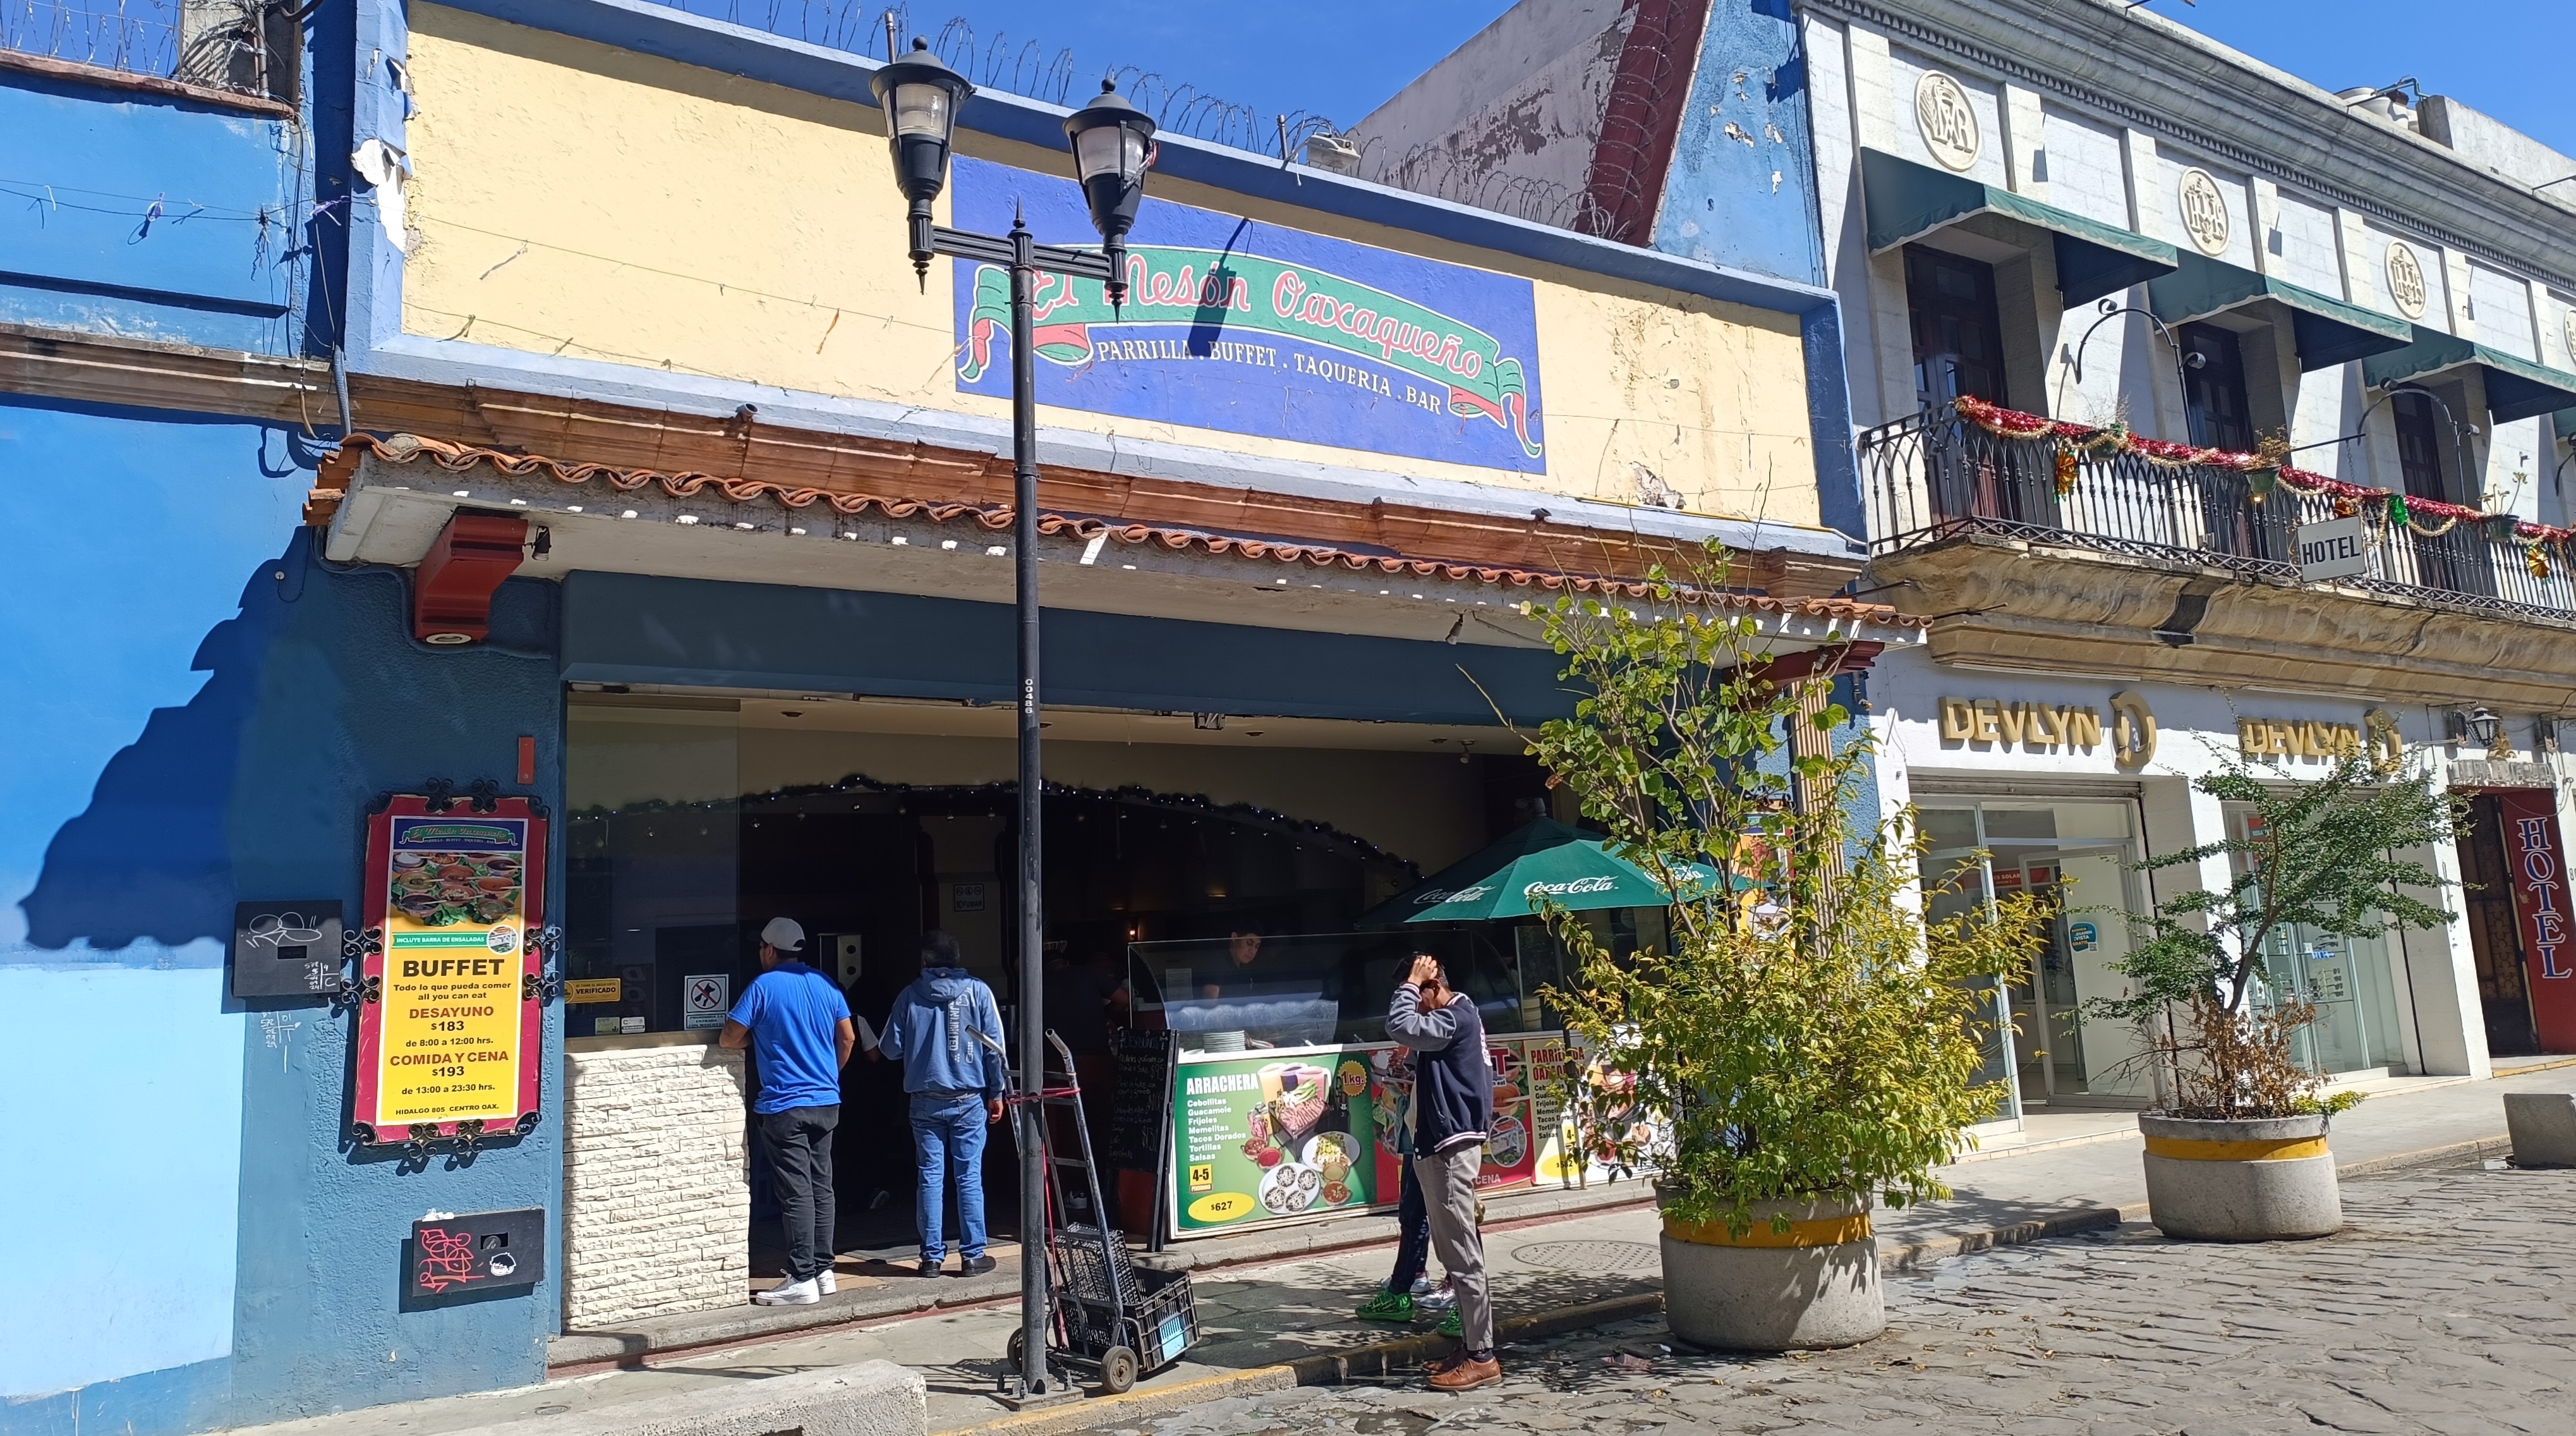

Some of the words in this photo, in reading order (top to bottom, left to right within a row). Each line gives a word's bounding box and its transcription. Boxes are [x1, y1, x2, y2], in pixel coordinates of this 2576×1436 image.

[1104, 253, 1252, 312] Mesón
[1272, 271, 1482, 379] Oaxaqueño
[1096, 341, 1195, 362] PARRILLA
[1208, 341, 1277, 368] BUFFET
[1293, 353, 1392, 398] TAQUERIA
[1405, 385, 1442, 415] BAR
[2302, 535, 2361, 565] HOTEL
[1025, 678, 1034, 714] 00486
[1938, 696, 2102, 746] DEVLYN
[2239, 717, 2362, 757] DEVLYN
[1523, 875, 1619, 896] Coca-Cola
[1413, 885, 1497, 904] Coca-Cola
[2517, 817, 2573, 979] HOTEL
[403, 959, 505, 977] BUFFET
[451, 983, 480, 991] pueda
[409, 1006, 494, 1019] DESAYUNO
[431, 1021, 464, 1031] $183
[450, 1037, 475, 1045] 12:00
[390, 1054, 452, 1066] COMIDA
[455, 1053, 465, 1063] Y
[468, 1050, 509, 1062] CENA
[1530, 1046, 1585, 1064] PARRILDA
[432, 1066, 464, 1077] $193
[416, 1086, 440, 1094] 13:00
[451, 1084, 476, 1092] 23:30
[1187, 1073, 1259, 1095] ARRACHERA
[1187, 1098, 1226, 1107] Cebollitas
[1188, 1106, 1231, 1116] Guacamole
[1188, 1117, 1218, 1126] Frijoles
[1188, 1125, 1229, 1135] Memelitas
[1214, 1133, 1246, 1141] Dorados
[1189, 1143, 1221, 1152] Tortillas
[1189, 1153, 1216, 1162] Salsas
[1193, 1168, 1209, 1181] 4-5
[1475, 1174, 1501, 1185] CENA
[1211, 1201, 1233, 1212] $627
